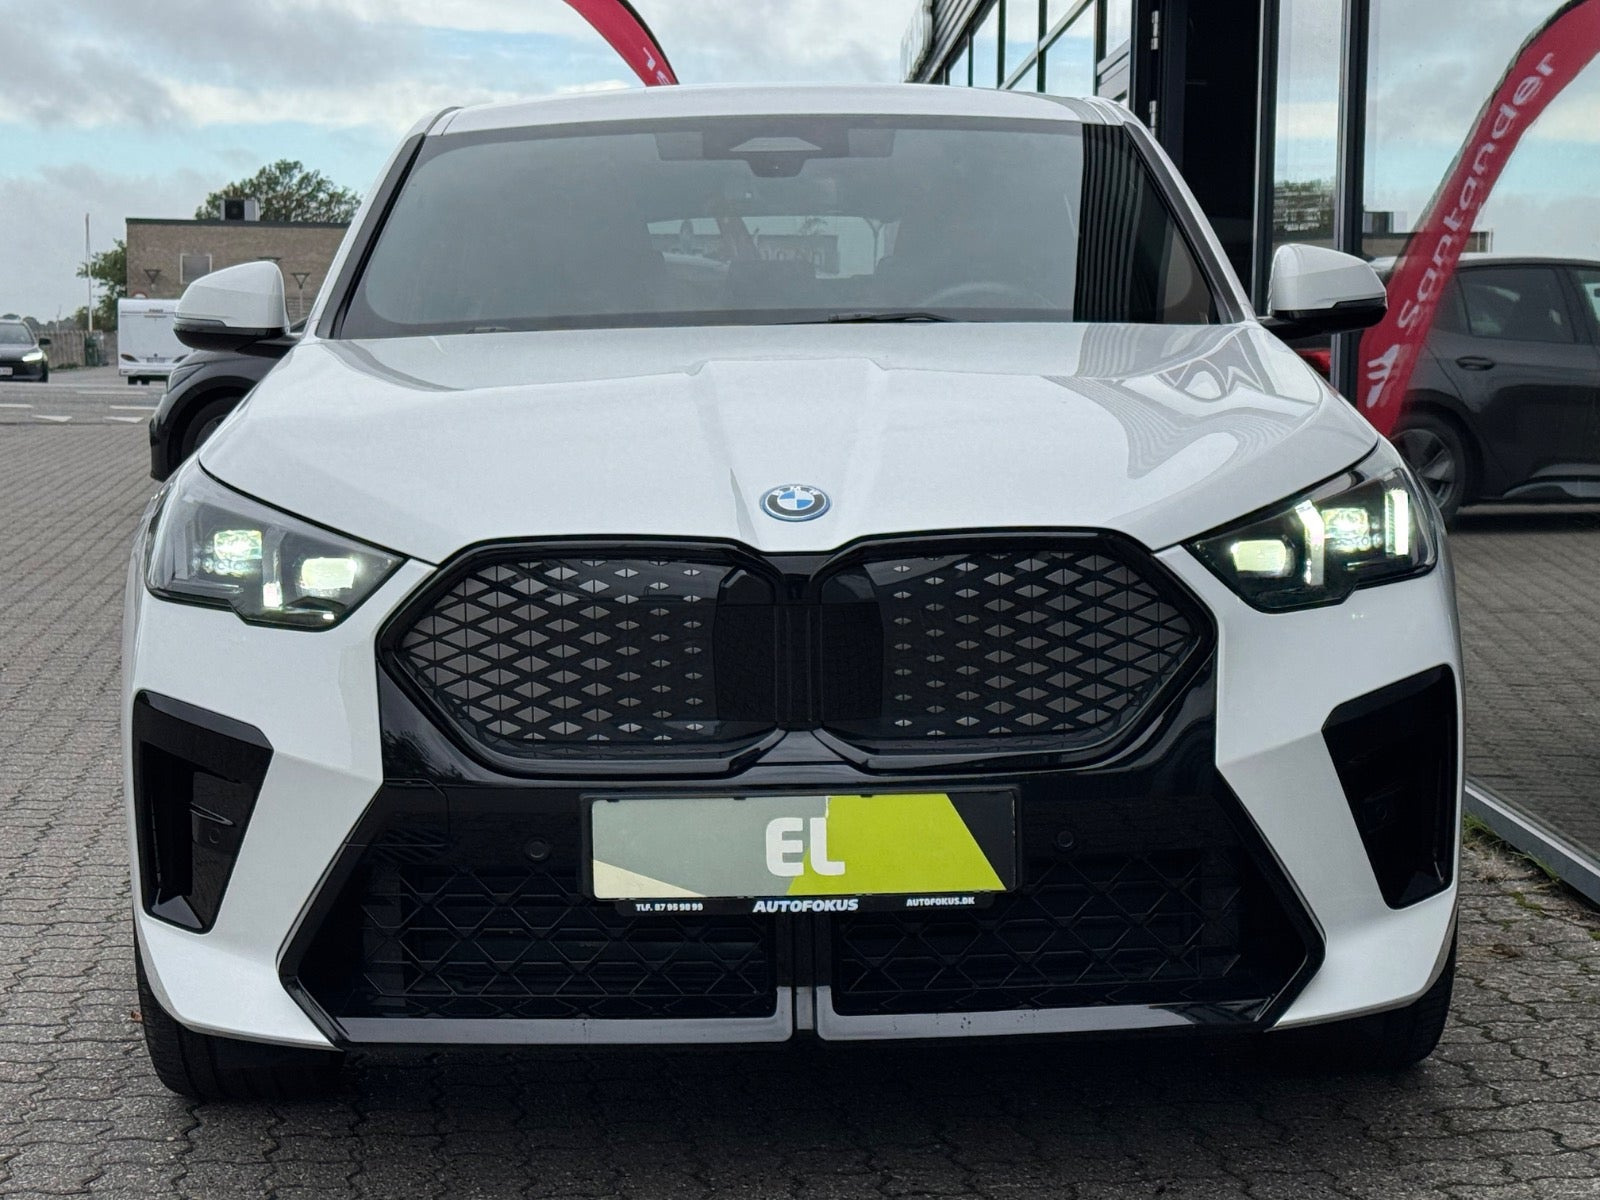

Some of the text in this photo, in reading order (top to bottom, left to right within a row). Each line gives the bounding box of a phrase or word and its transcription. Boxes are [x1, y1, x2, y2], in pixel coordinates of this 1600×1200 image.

[1397, 51, 1556, 332] Santander
[765, 816, 845, 877] EL
[636, 903, 653, 912] TLF.
[752, 899, 859, 913] AUTOFOKUS
[906, 897, 975, 907] AUTOFOKUS.DK
